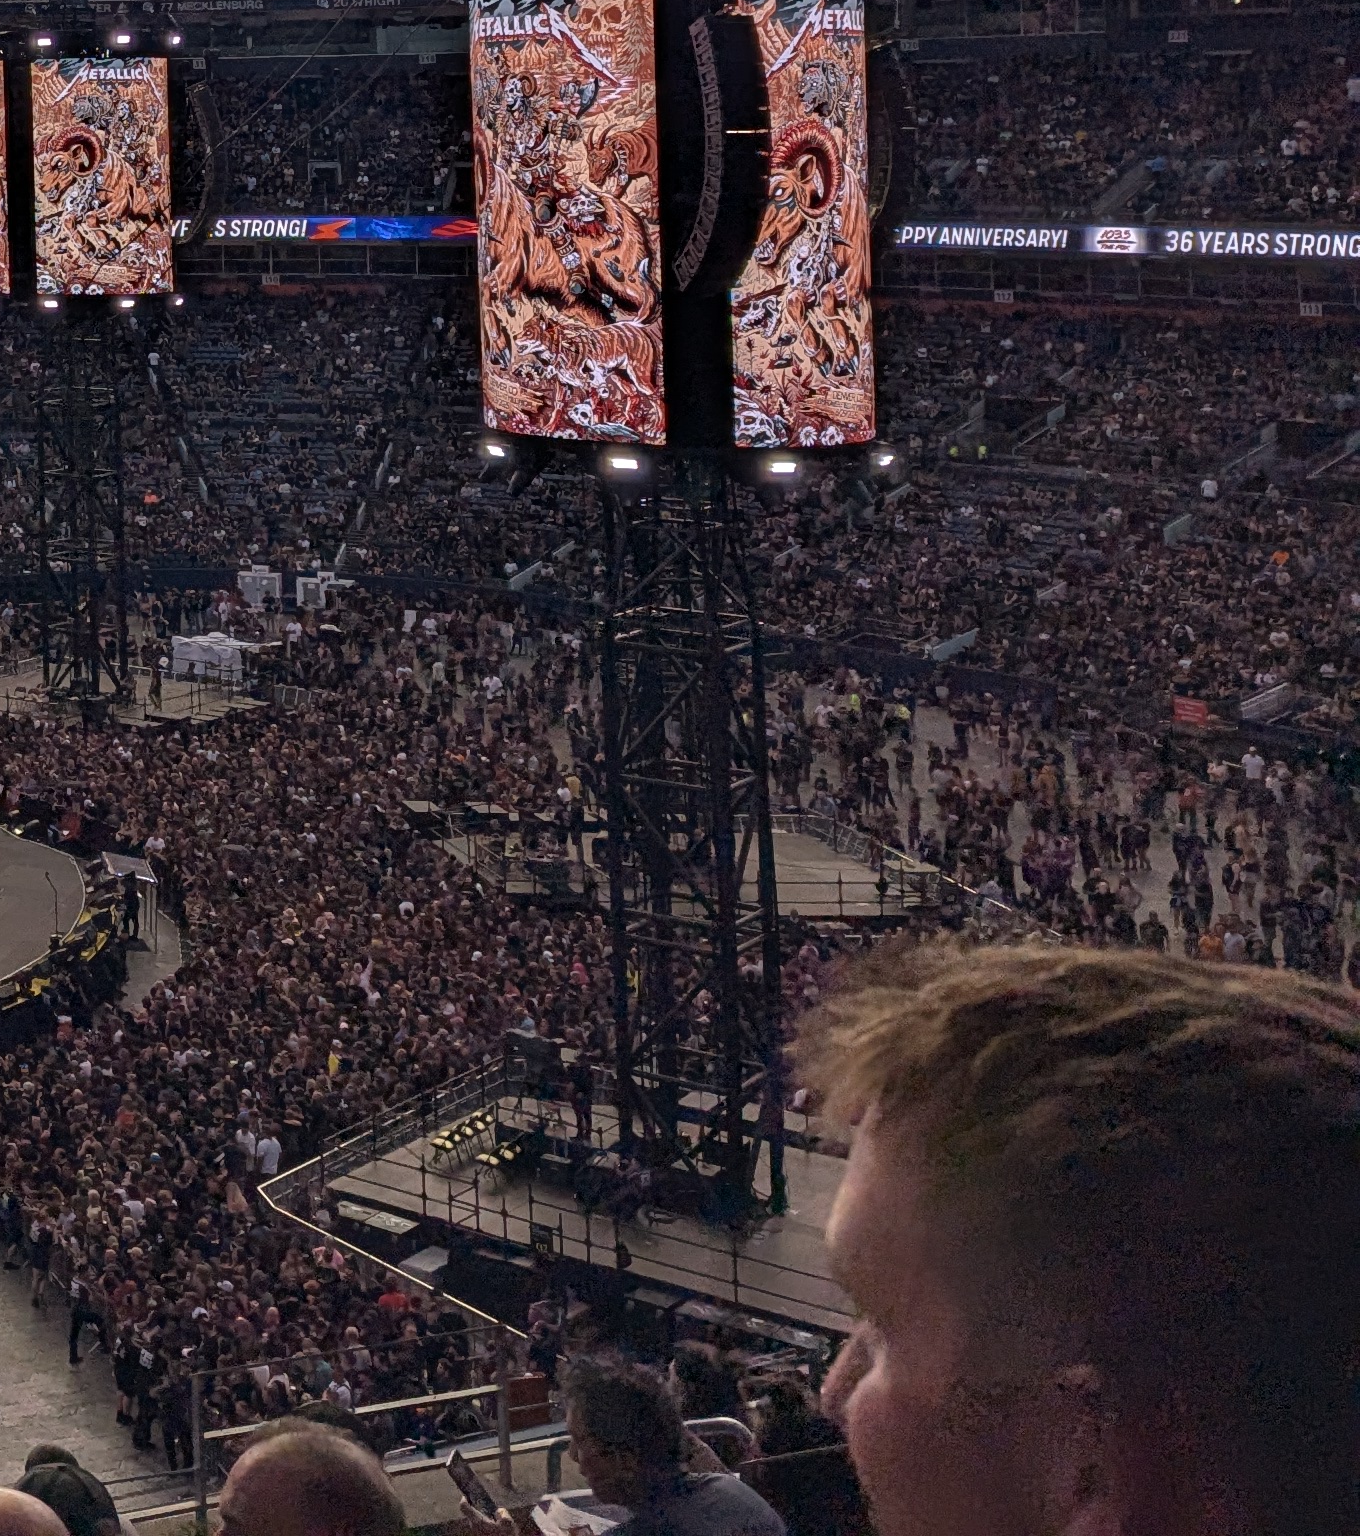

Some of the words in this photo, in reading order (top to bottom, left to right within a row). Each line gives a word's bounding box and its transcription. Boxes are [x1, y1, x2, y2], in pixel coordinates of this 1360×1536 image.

[178, 0, 264, 11] MECKLENBURG
[230, 219, 308, 238] STRONG!
[894, 226, 937, 245] PPY
[938, 227, 1067, 249] ANNIVERSARY!
[1165, 231, 1193, 252] 36
[1198, 231, 1269, 254] YEARS
